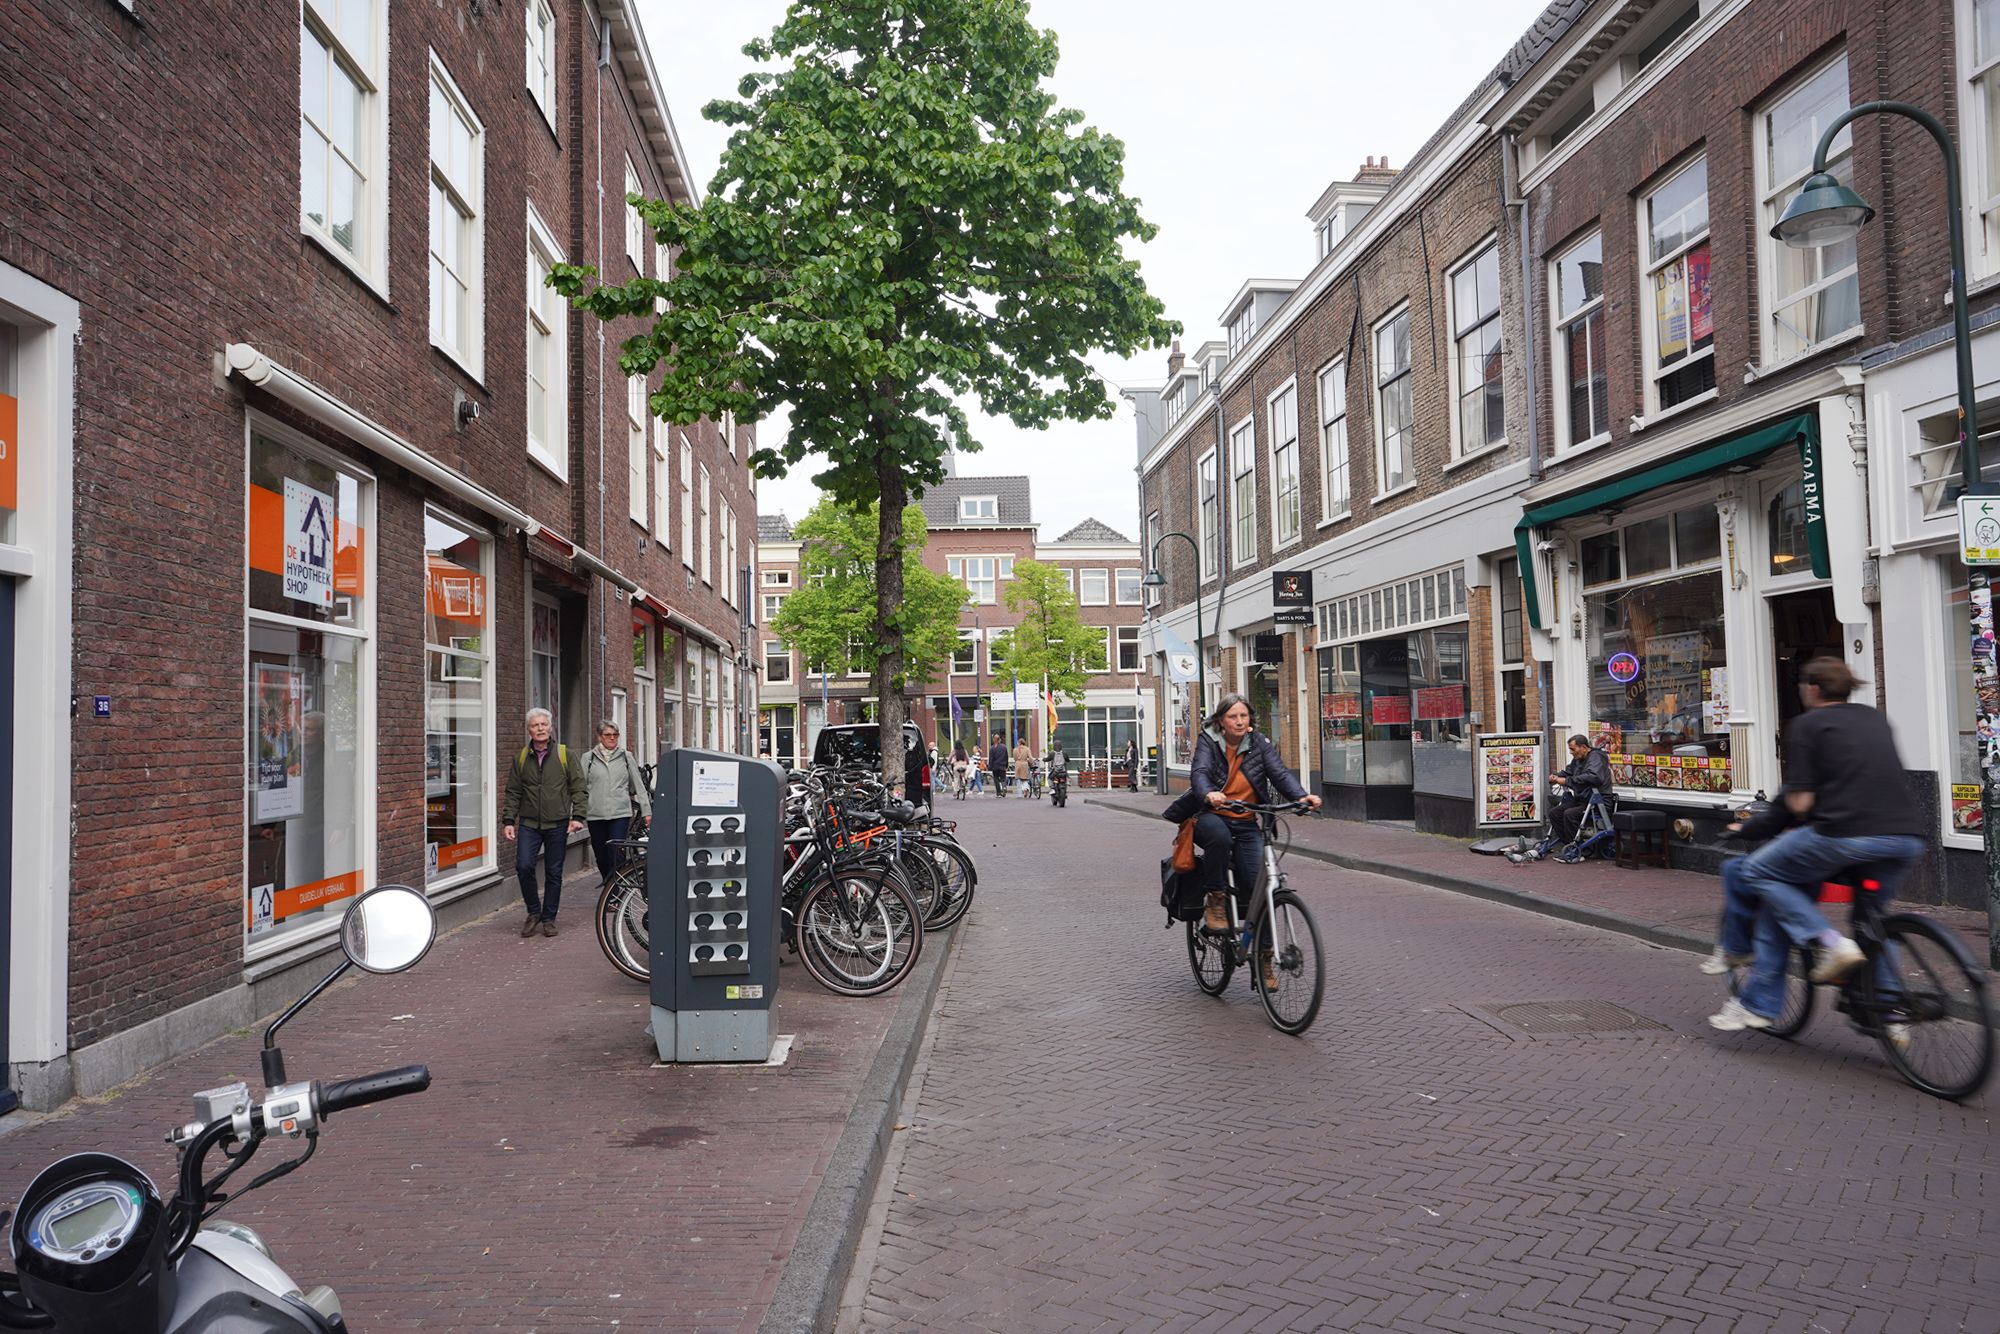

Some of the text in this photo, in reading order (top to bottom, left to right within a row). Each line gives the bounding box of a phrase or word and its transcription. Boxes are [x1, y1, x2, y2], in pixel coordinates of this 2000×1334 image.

[287, 544, 297, 560] DE
[286, 561, 331, 587] HYPOTHEEK
[286, 577, 308, 595] SHOP
[1853, 639, 1863, 655] 9
[1611, 661, 1636, 673] OPEN
[105, 705, 120, 720] 36
[299, 882, 346, 904] DUIDELIJK VERHAAL
